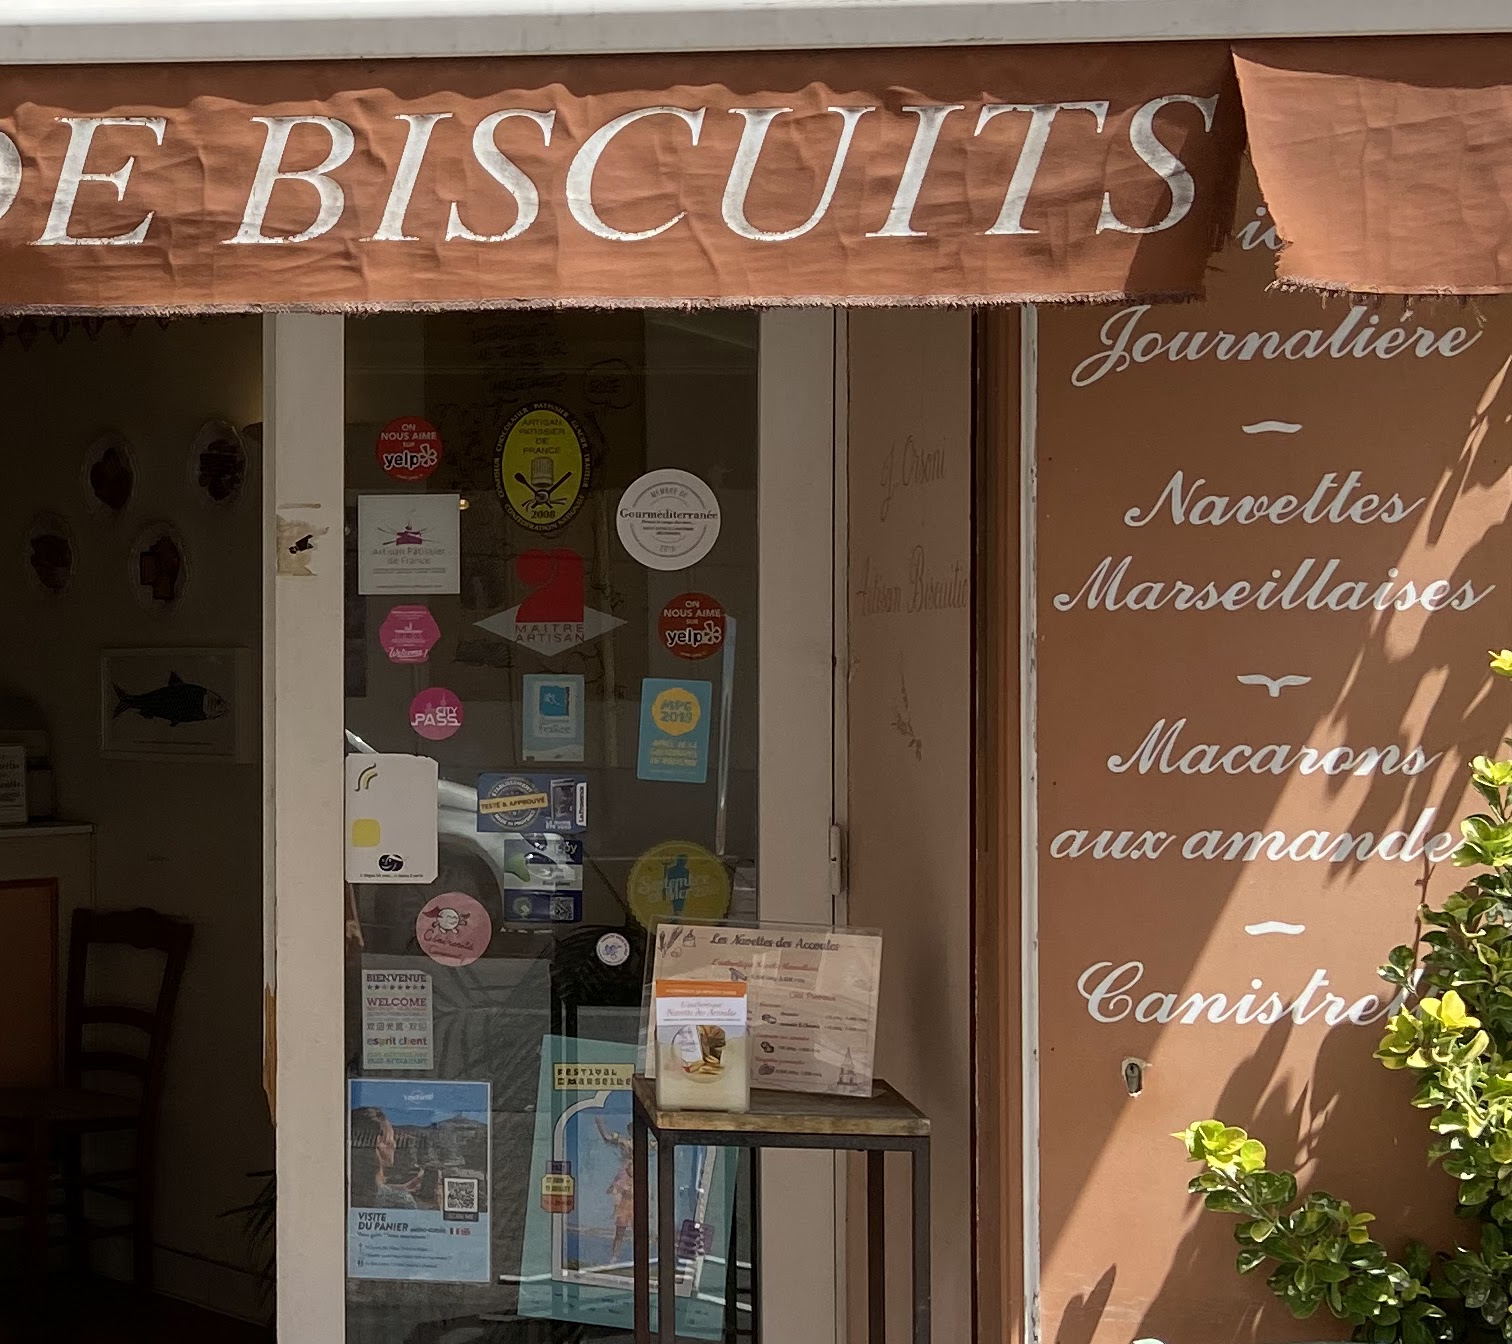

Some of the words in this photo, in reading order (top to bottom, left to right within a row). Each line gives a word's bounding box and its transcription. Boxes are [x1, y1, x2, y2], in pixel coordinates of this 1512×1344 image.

[219, 92, 1221, 248] BISCUITS
[381, 432, 410, 441] NOUS
[412, 432, 438, 441] AIME
[383, 451, 420, 470] yelp
[1123, 470, 1426, 528] Navettes
[1053, 555, 1497, 612] Marseillaises
[664, 609, 693, 617] NOUS
[696, 609, 720, 617] AIME
[515, 624, 584, 633] MAITRE
[515, 634, 584, 643] ARTISAN
[666, 628, 703, 647] yelp
[436, 707, 458, 716] CITY
[411, 714, 462, 726] PASS
[1107, 717, 1443, 776] Macarons
[1050, 828, 1176, 860] aux
[1182, 807, 1467, 862] amande
[710, 933, 727, 945] Les
[731, 934, 773, 947] Navettes
[776, 937, 792, 948] des
[794, 938, 840, 951] Accoules
[366, 973, 427, 982] BIENVENUE
[367, 998, 427, 1006] WELCOME
[367, 1037, 396, 1047] esprit
[358, 1212, 386, 1222] VISITE
[358, 1222, 373, 1231] DU
[374, 1223, 409, 1232] PANIER
